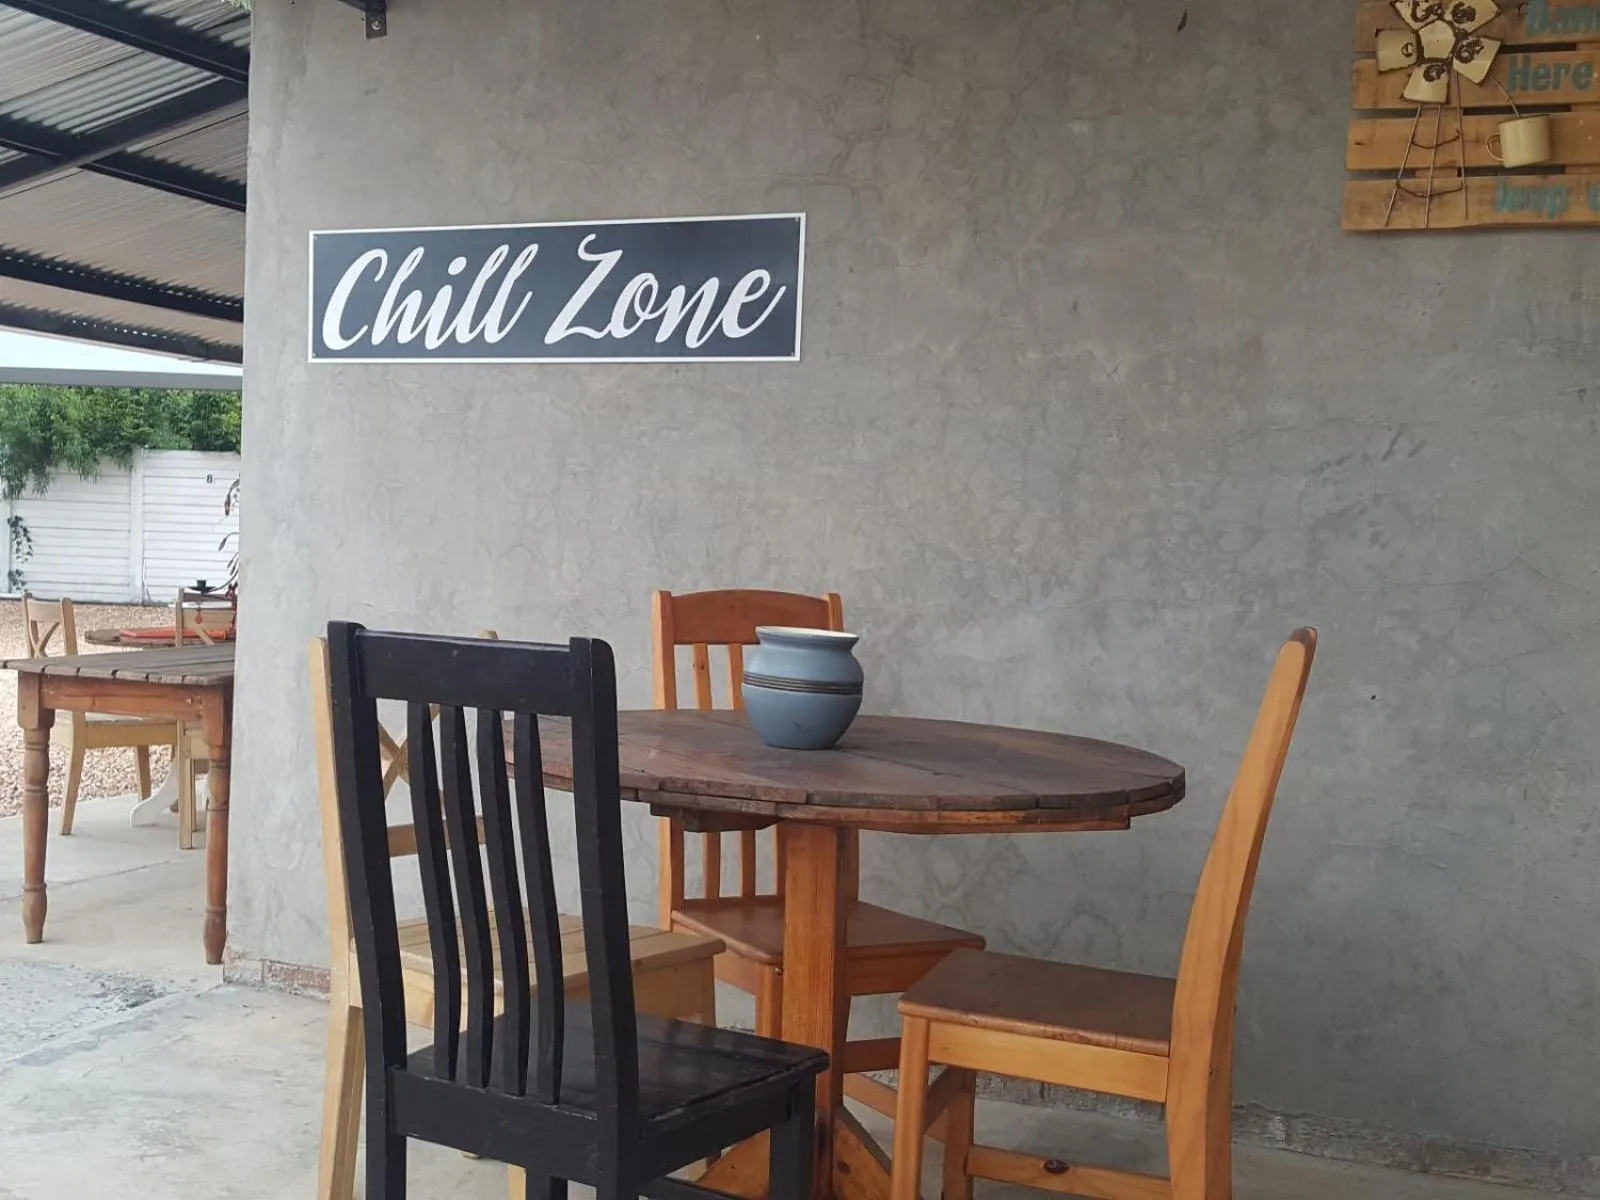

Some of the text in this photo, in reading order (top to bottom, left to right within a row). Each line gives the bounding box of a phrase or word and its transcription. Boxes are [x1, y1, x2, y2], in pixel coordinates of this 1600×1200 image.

[1507, 54, 1594, 92] Here
[322, 233, 787, 351] Chill Zone
